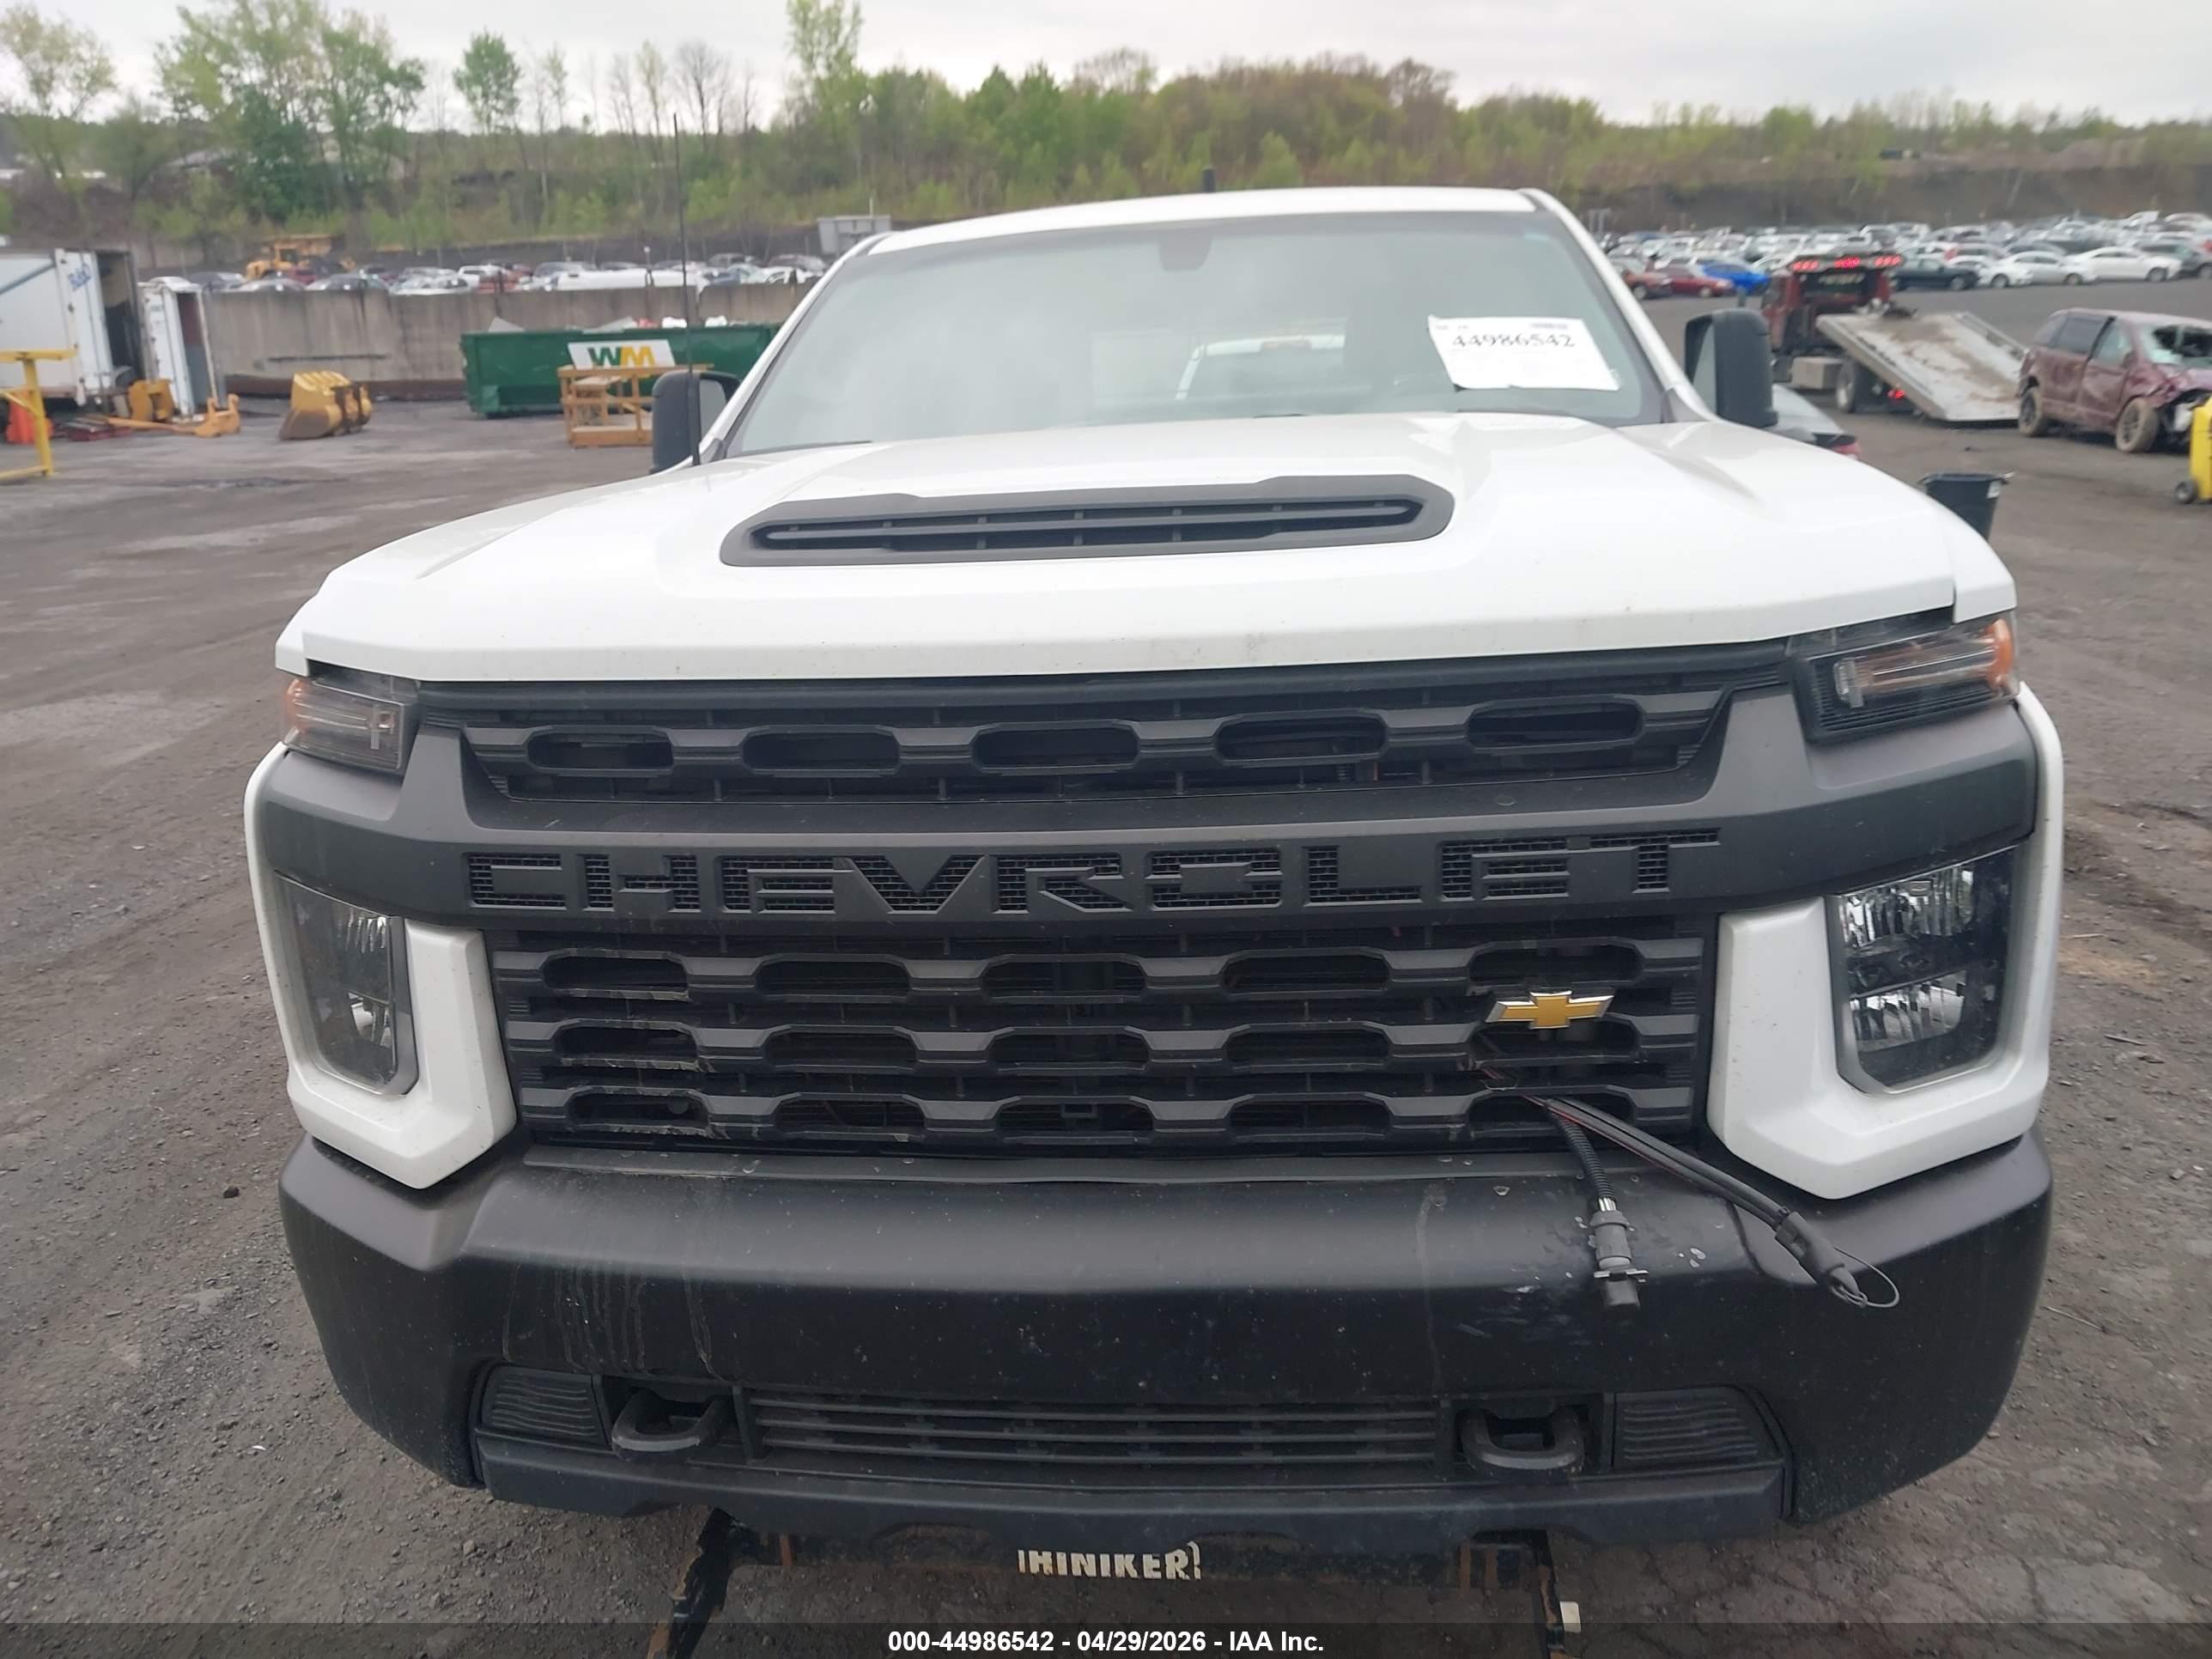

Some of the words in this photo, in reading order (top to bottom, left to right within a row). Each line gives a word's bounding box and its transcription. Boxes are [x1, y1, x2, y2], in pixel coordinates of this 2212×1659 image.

[1452, 333, 1577, 348] 44986542
[587, 346, 657, 369] WM
[464, 827, 1721, 915] CHEVROLET
